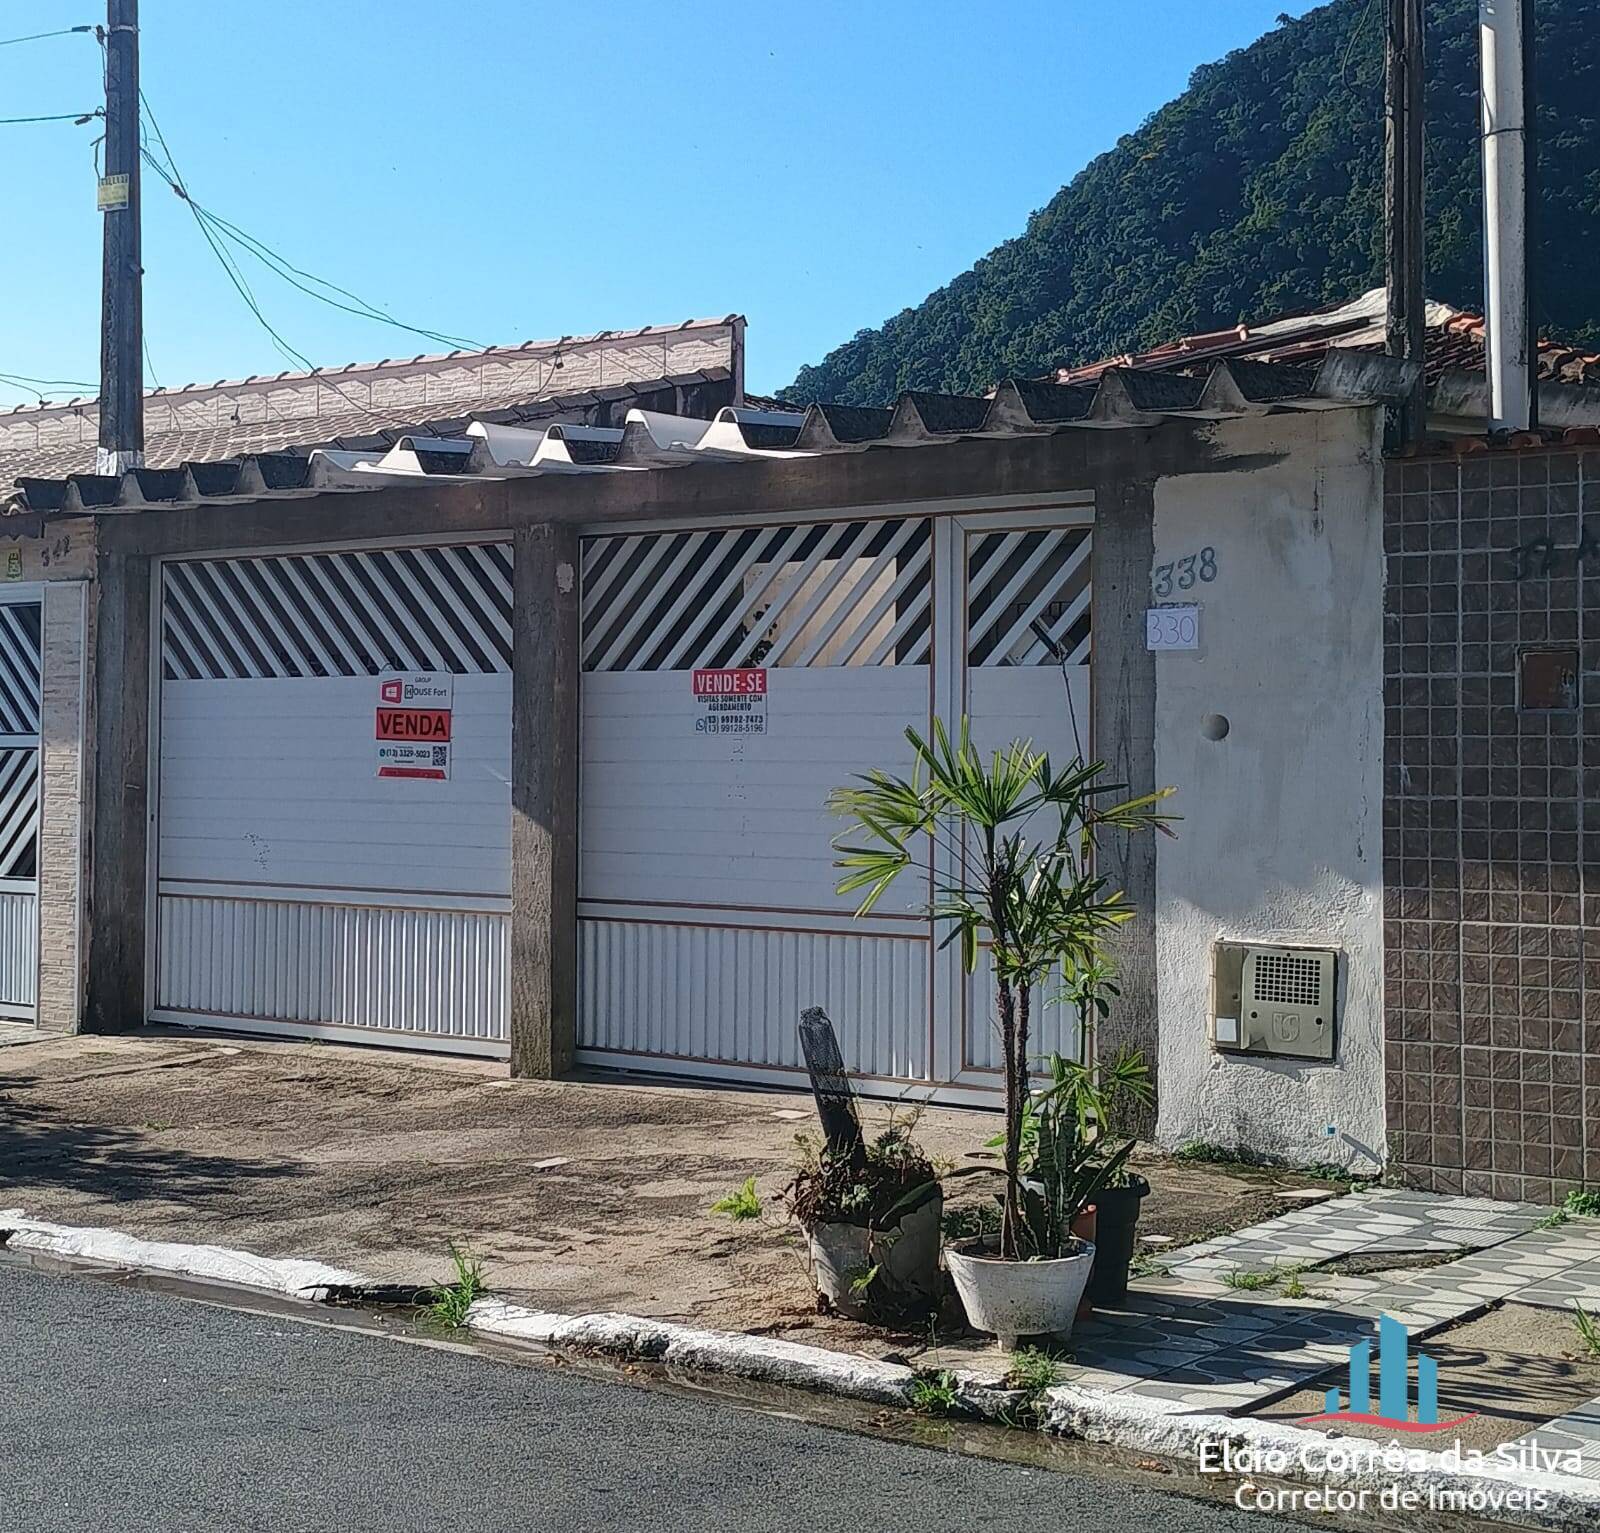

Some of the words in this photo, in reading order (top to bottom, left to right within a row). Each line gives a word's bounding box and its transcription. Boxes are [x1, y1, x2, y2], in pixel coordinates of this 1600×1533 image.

[1155, 547, 1217, 597] 338
[1150, 614, 1195, 645] 330
[697, 673, 763, 692] VENDE-SE
[405, 685, 433, 699] HOUSE
[433, 688, 447, 697] Fort
[697, 694, 719, 703] VISITAS
[720, 694, 748, 703] SOMENTE
[749, 694, 763, 702] COM
[708, 702, 752, 711] AGENDAMENTO
[380, 713, 447, 737] VENDA
[720, 724, 764, 733] 99128-5196
